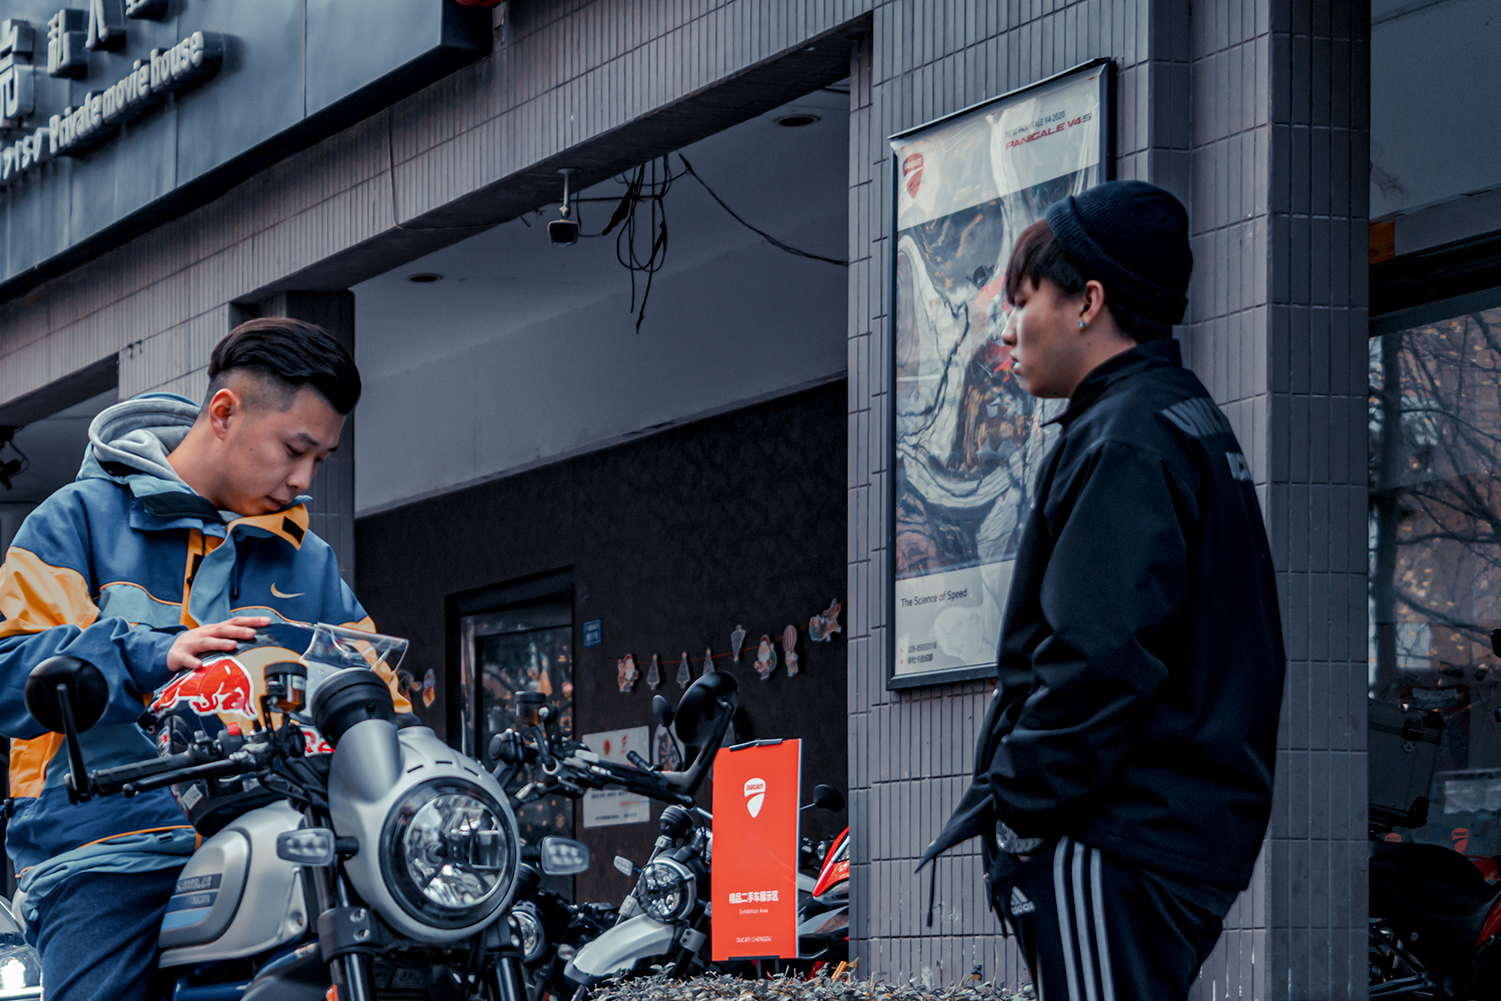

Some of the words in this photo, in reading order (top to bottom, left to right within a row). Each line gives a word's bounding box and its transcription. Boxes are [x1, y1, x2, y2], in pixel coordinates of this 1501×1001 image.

[49, 91, 102, 154] Private
[102, 59, 149, 120] movie
[150, 31, 204, 92] house
[1005, 122, 1065, 150] PANIGALE
[901, 598, 913, 607] The
[914, 595, 937, 606] Science
[939, 591, 946, 601] of
[947, 587, 968, 602] Speed
[746, 783, 763, 791] DUCATI
[729, 890, 779, 904] 精品二手车展示区
